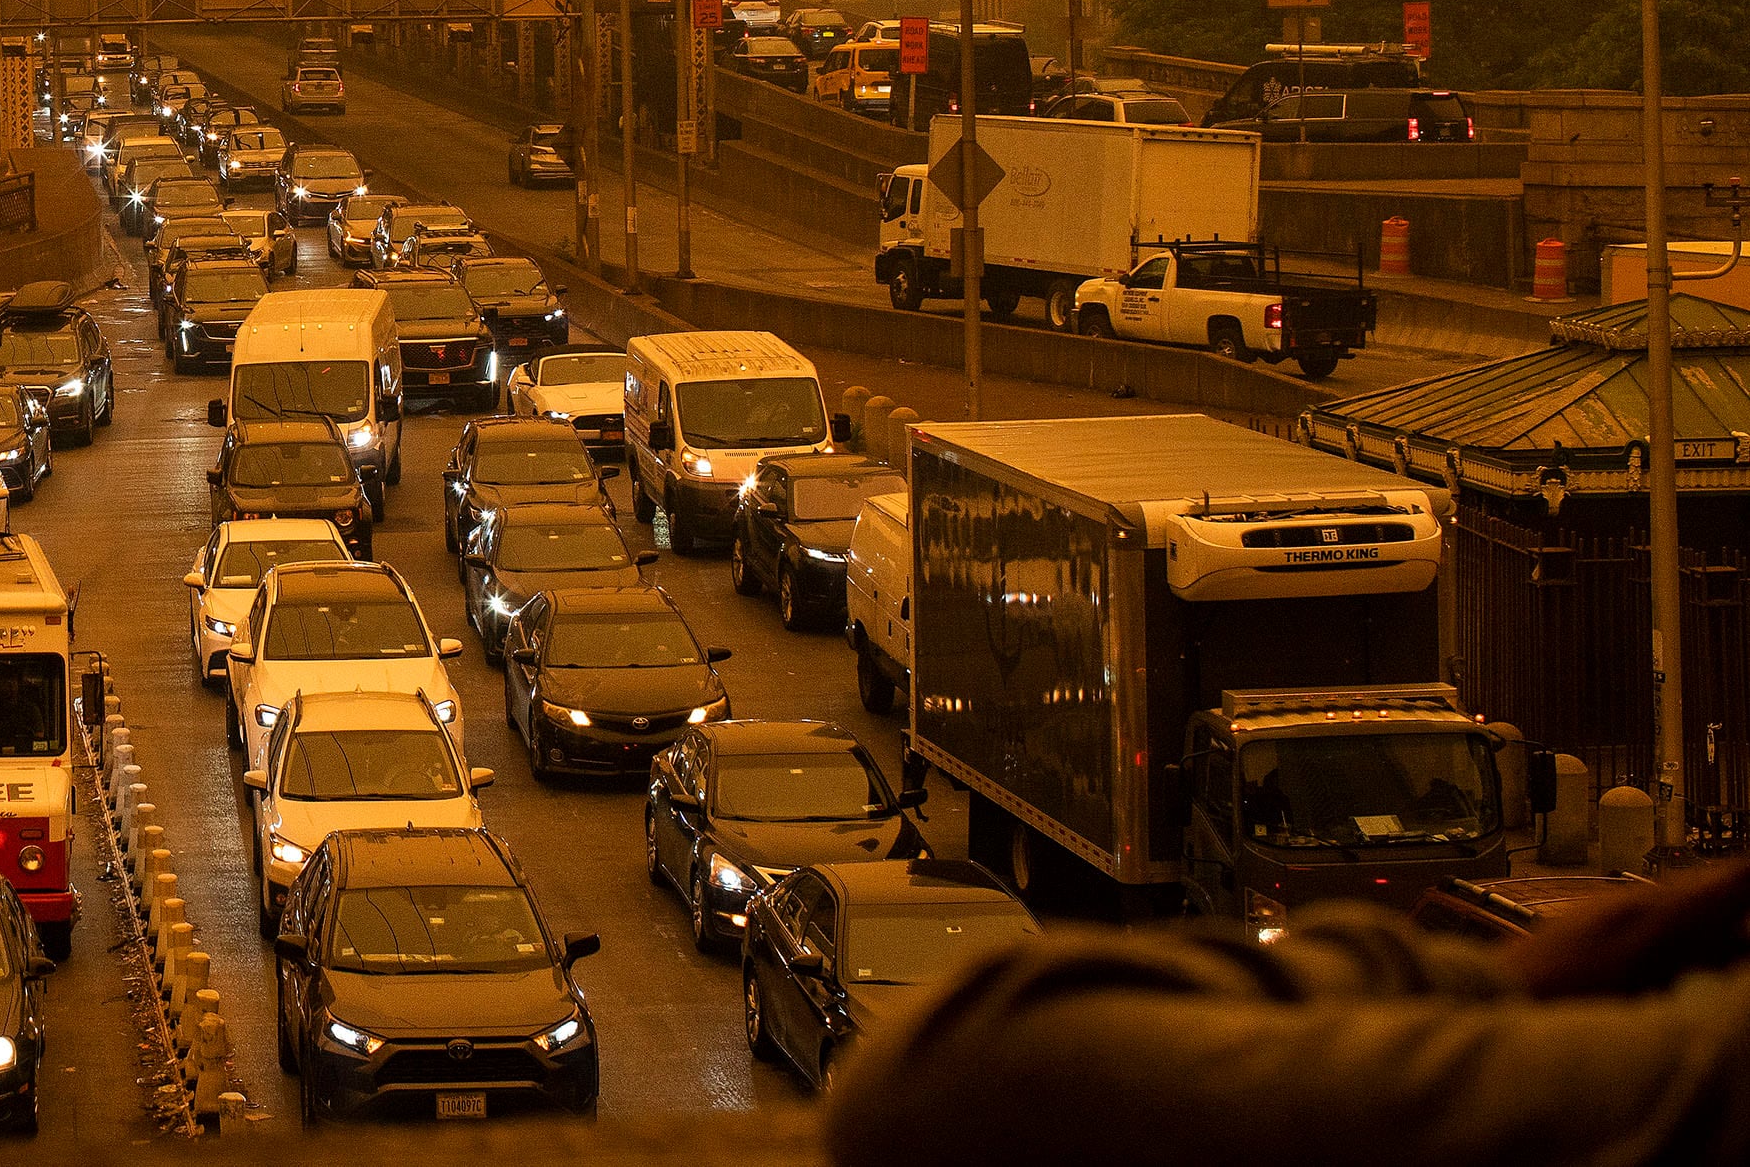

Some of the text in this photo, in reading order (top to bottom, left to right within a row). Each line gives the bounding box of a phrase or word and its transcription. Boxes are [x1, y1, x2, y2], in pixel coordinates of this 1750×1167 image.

[699, 11, 718, 24] 25
[905, 26, 924, 35] ROAD
[1682, 442, 1716, 457] EXIT
[1284, 548, 1378, 563] THERMO KING
